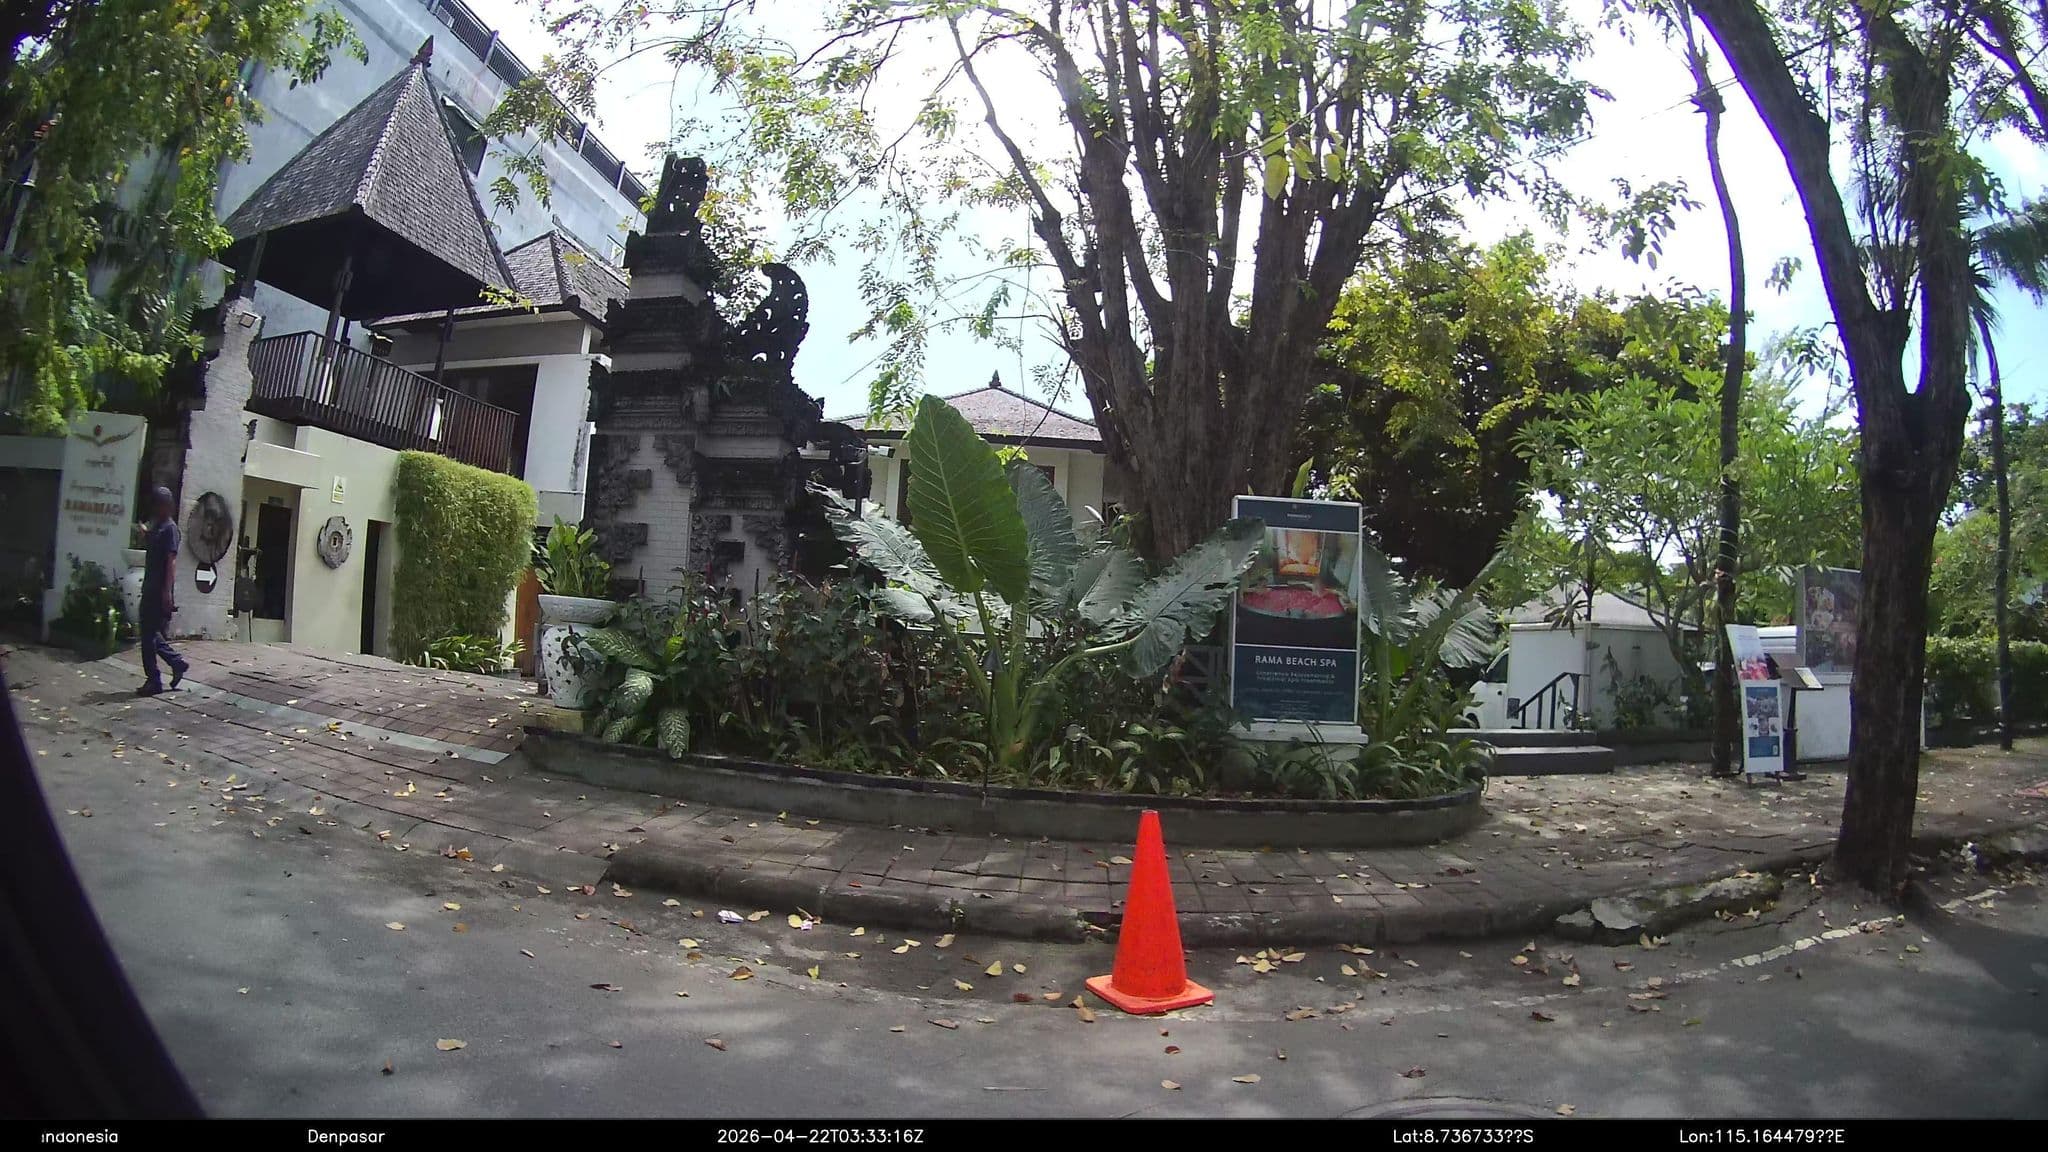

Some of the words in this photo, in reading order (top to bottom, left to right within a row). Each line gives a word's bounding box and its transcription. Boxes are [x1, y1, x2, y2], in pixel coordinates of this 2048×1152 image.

[1254, 655, 1283, 665] RAMA
[1286, 656, 1317, 667] BEACH
[1319, 658, 1337, 668] SPA
